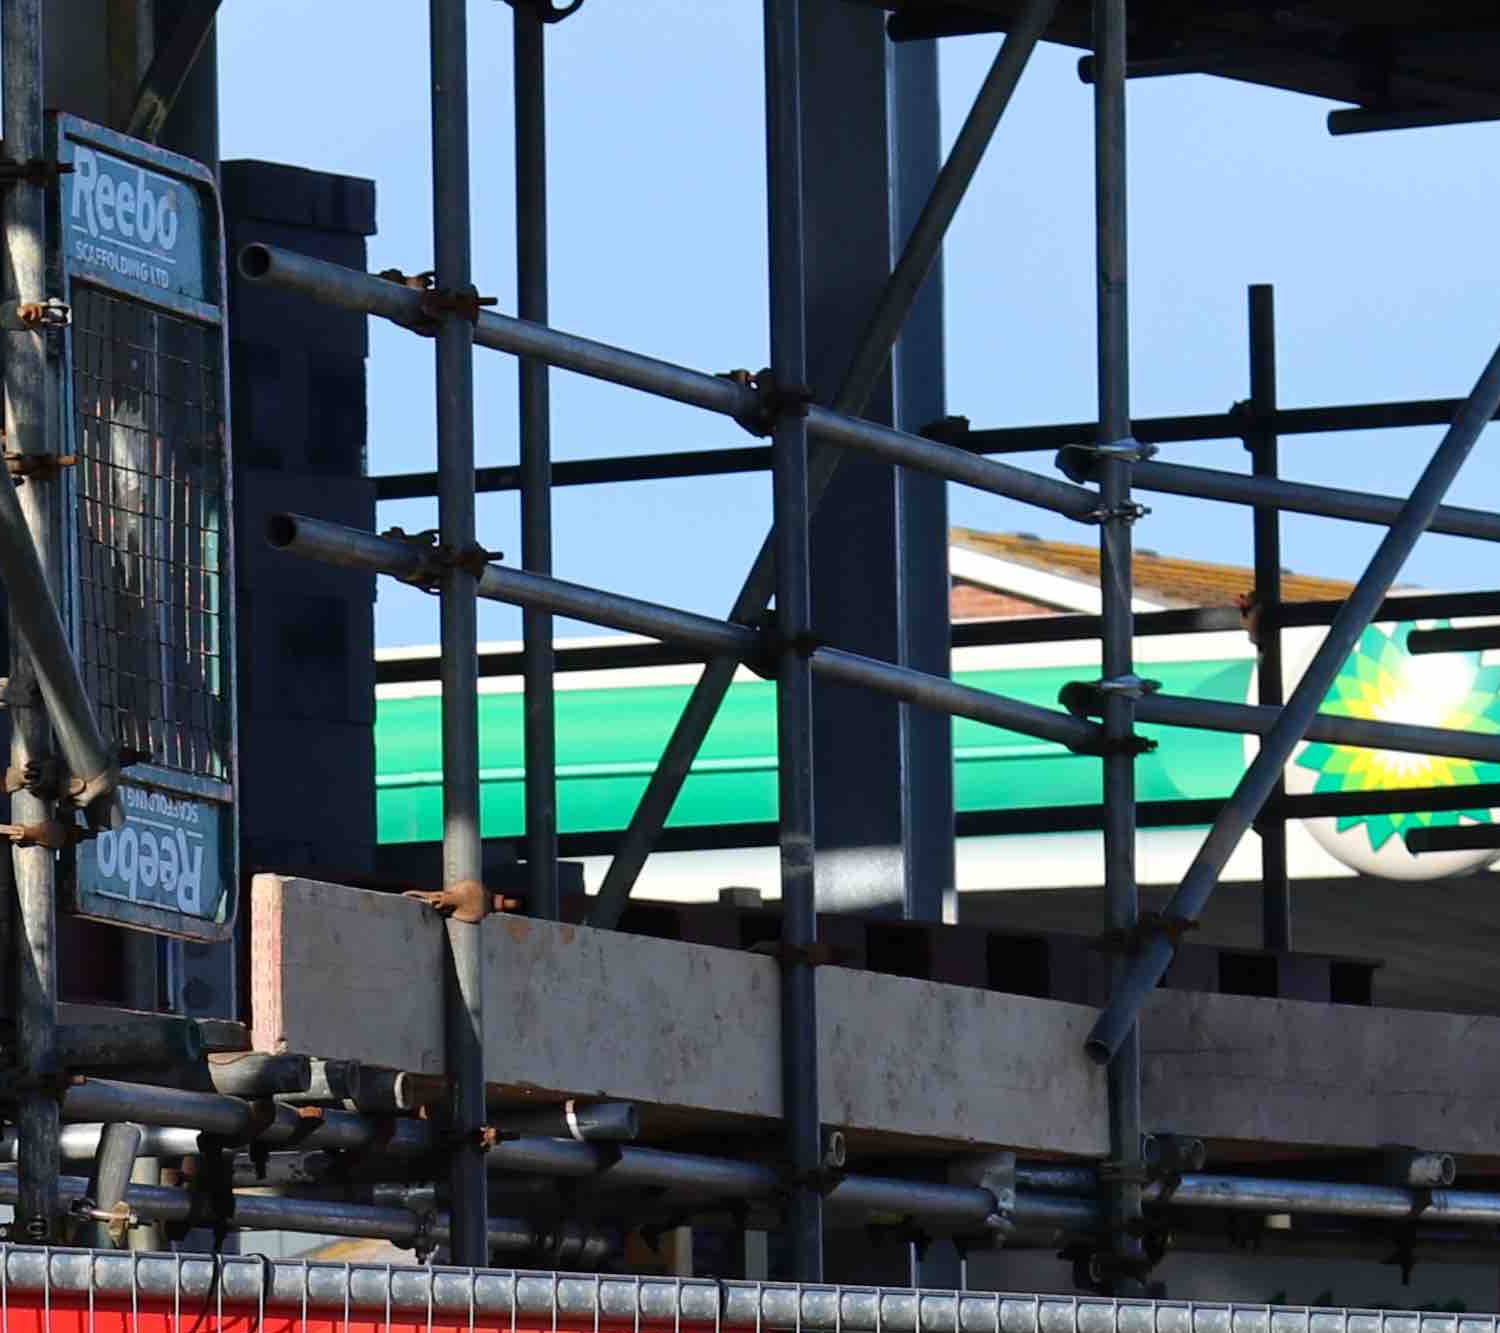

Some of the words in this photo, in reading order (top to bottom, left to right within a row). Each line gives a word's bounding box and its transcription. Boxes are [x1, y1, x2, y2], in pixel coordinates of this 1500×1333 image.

[71, 145, 178, 250] Reebo
[73, 240, 149, 282] SCAFFOLDING
[150, 269, 169, 289] LTD
[97, 826, 204, 913] Reebo
